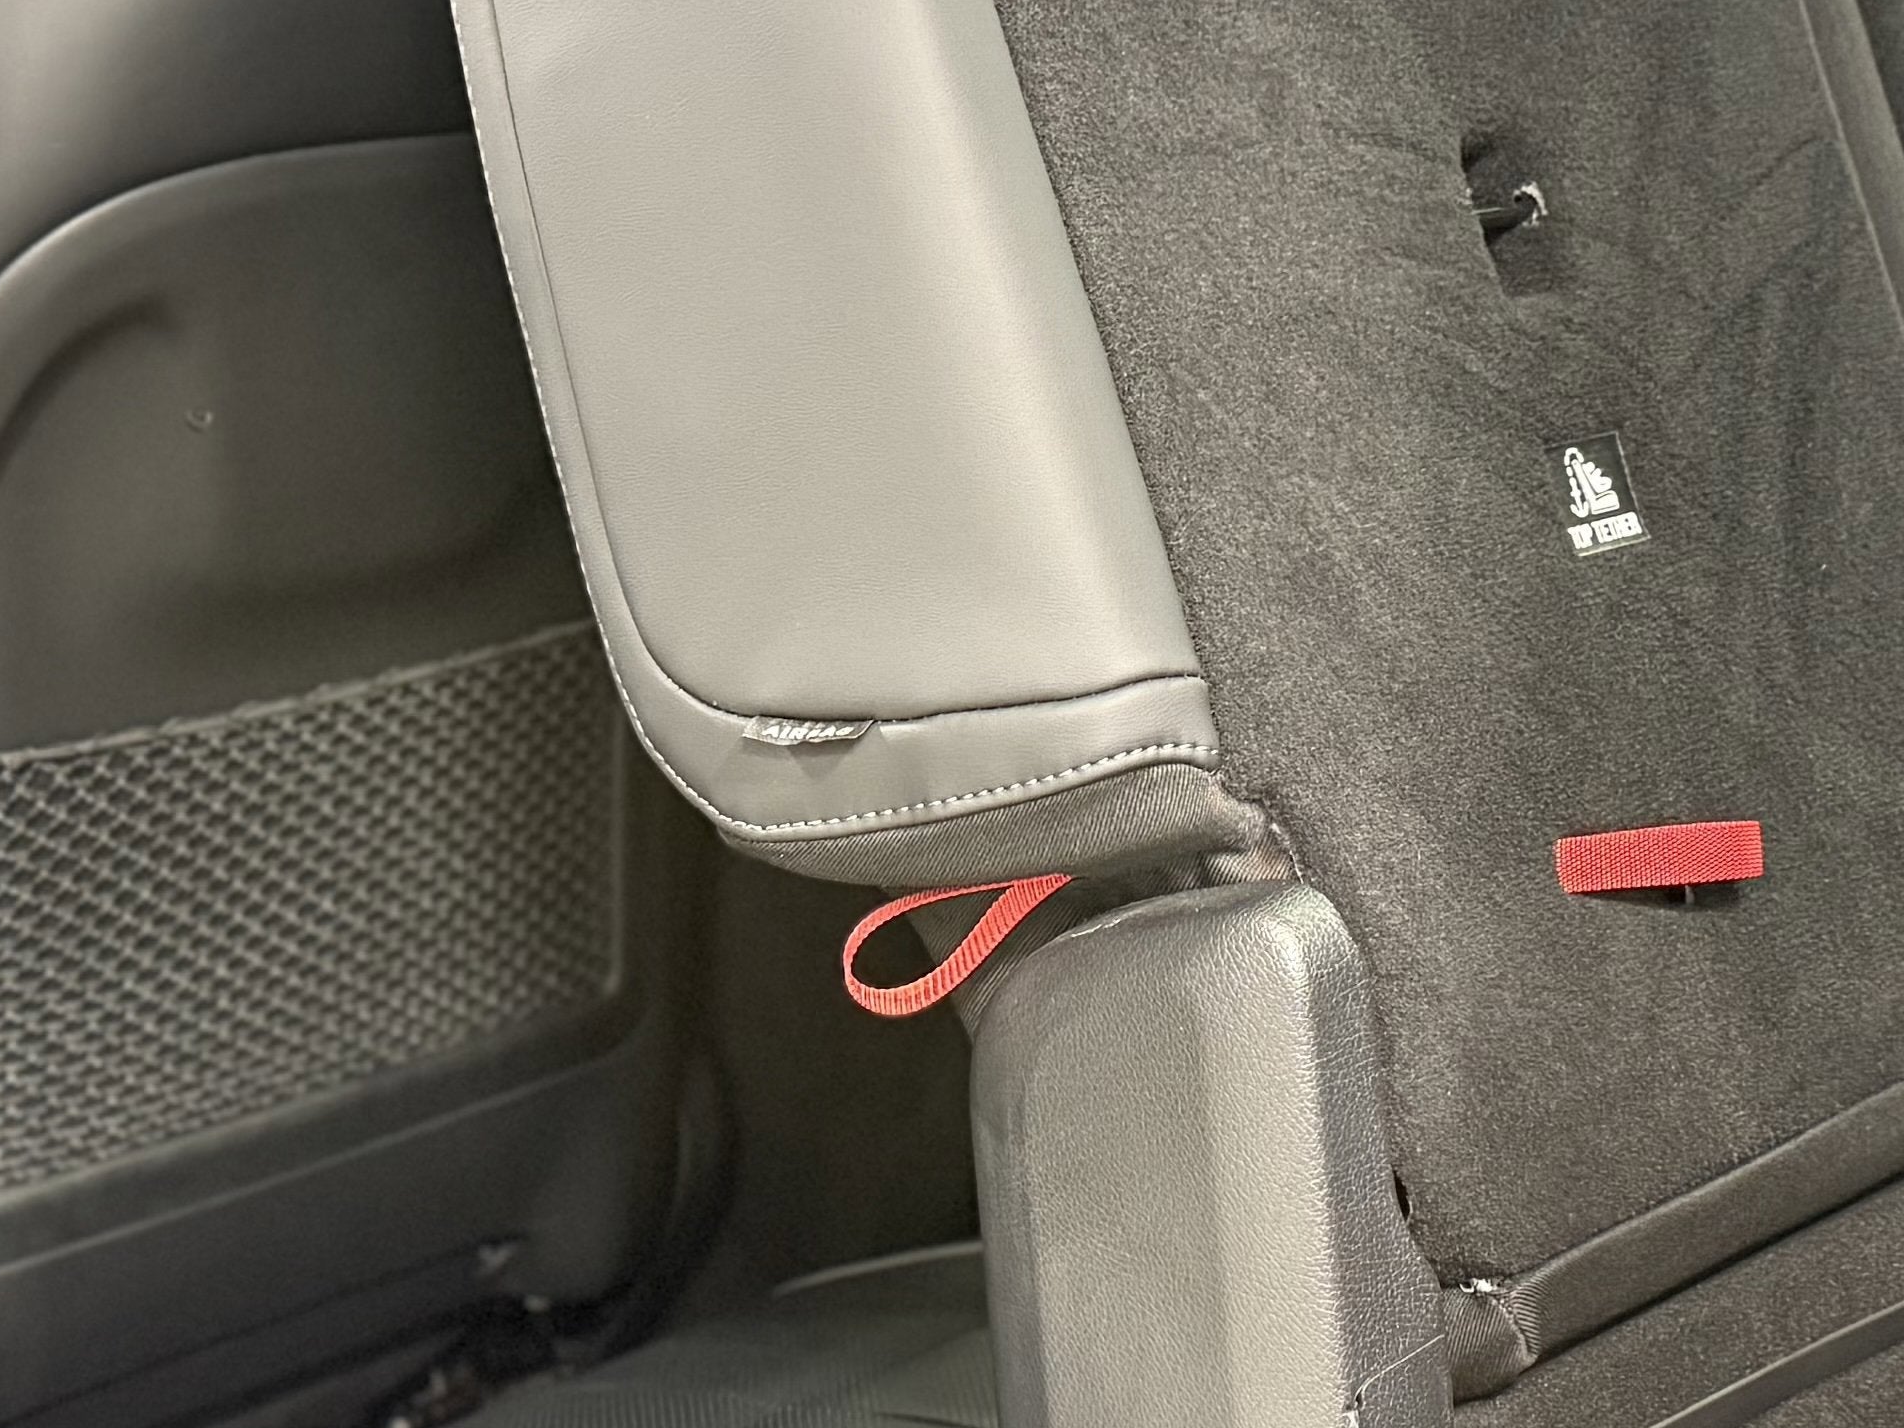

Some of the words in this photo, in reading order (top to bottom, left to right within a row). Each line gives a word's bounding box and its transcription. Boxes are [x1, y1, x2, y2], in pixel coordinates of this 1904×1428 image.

[1567, 523, 1594, 549] TOP
[1590, 511, 1643, 543] TETHER
[762, 725, 854, 740] AIRBAG
